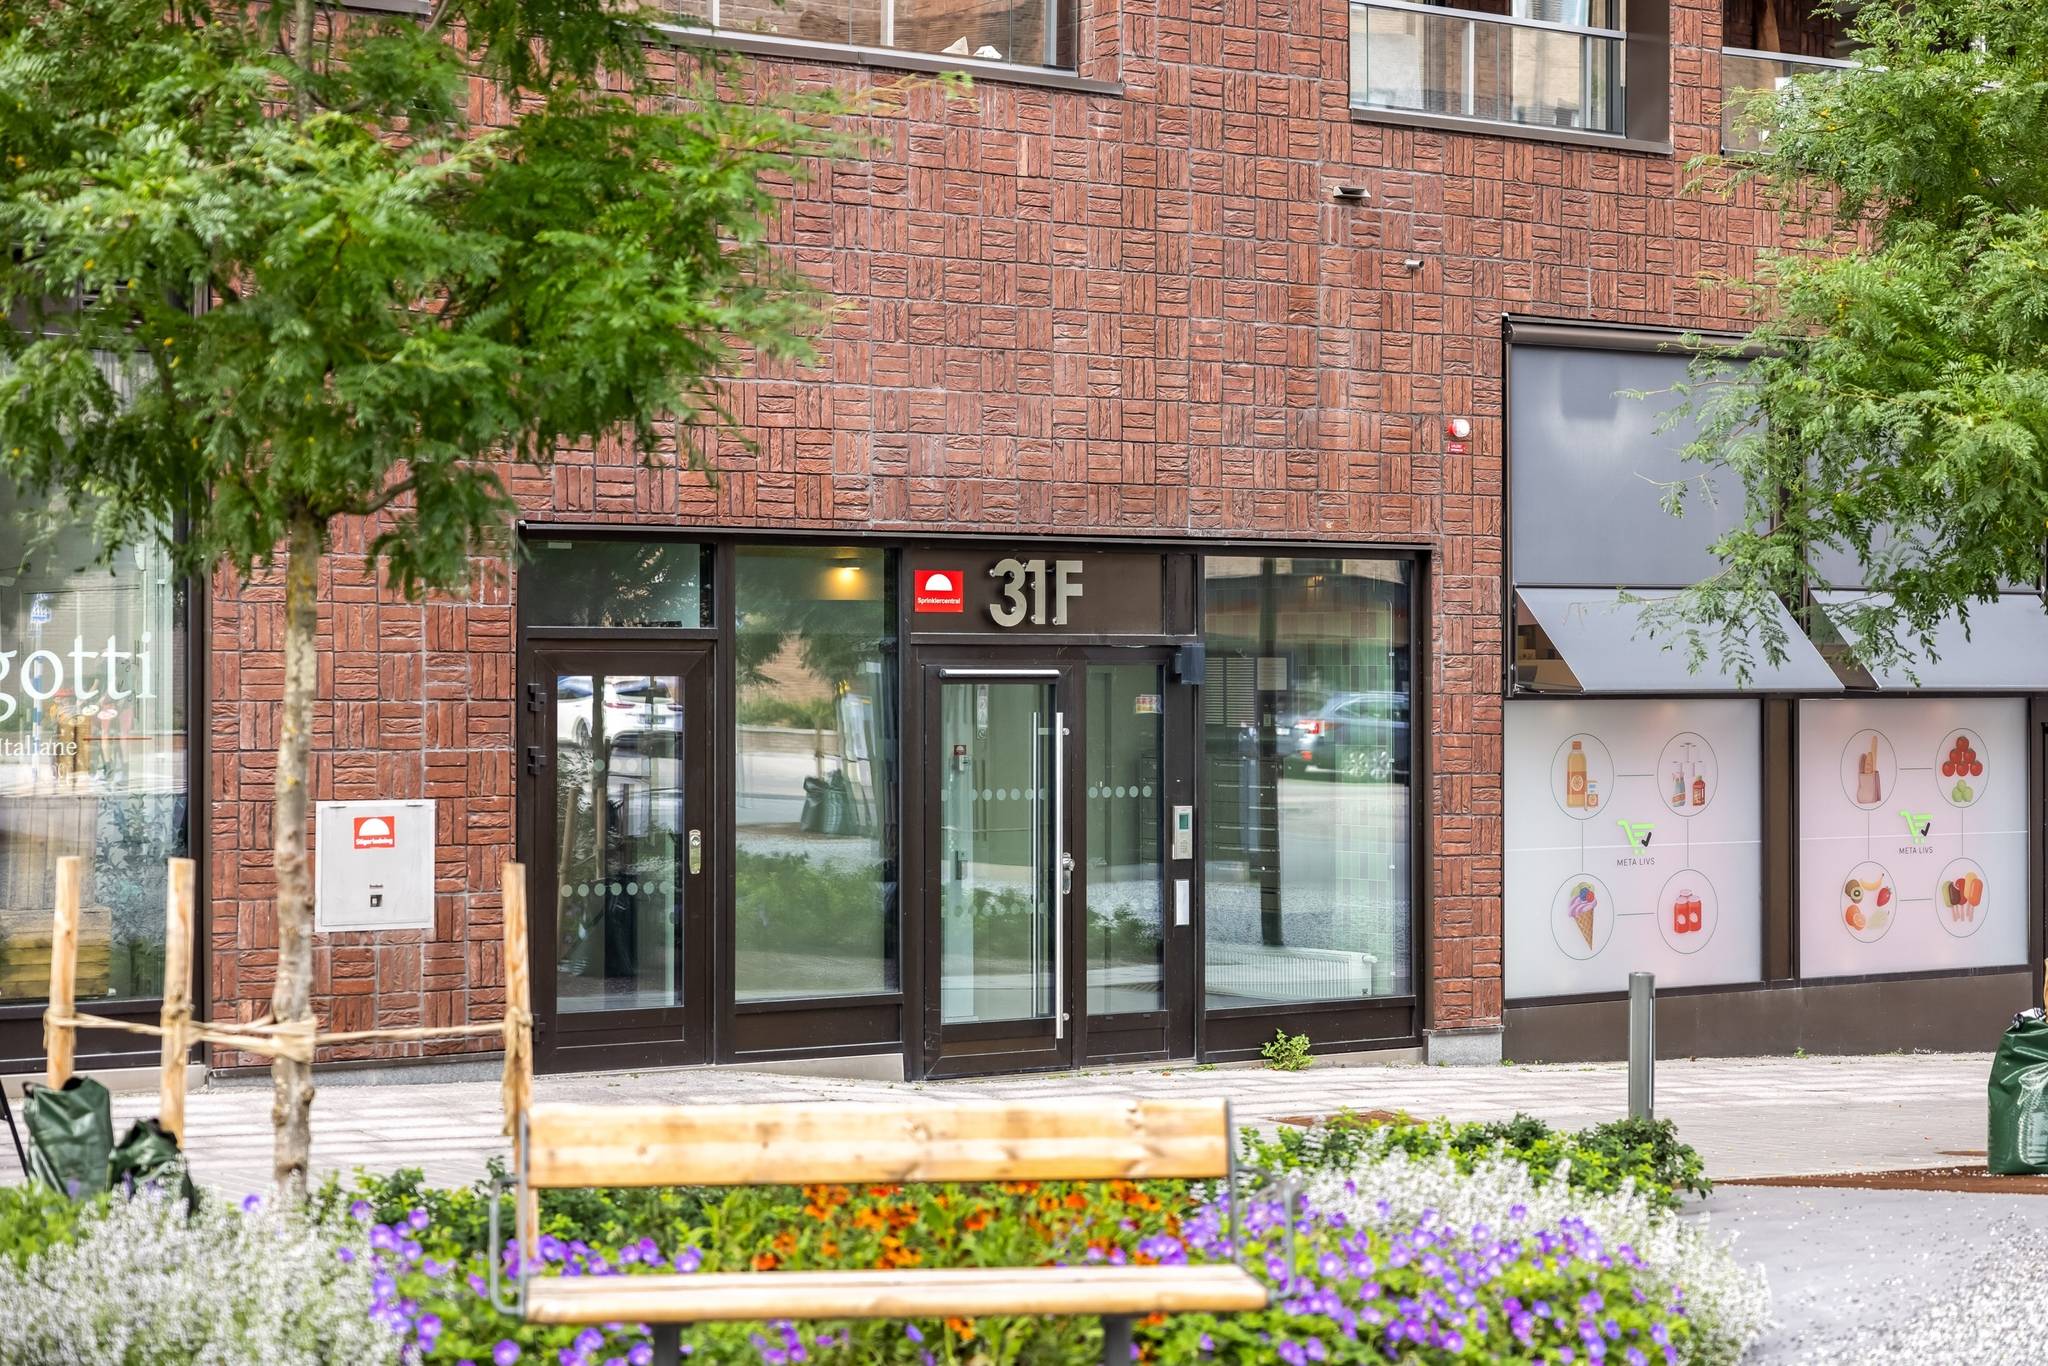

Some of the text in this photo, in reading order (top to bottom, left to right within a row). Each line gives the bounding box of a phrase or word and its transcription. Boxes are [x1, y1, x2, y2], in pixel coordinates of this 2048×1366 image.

[989, 558, 1083, 627] 31F
[1899, 846, 1934, 855] META LIVS
[1616, 857, 1656, 867] META LIVS
